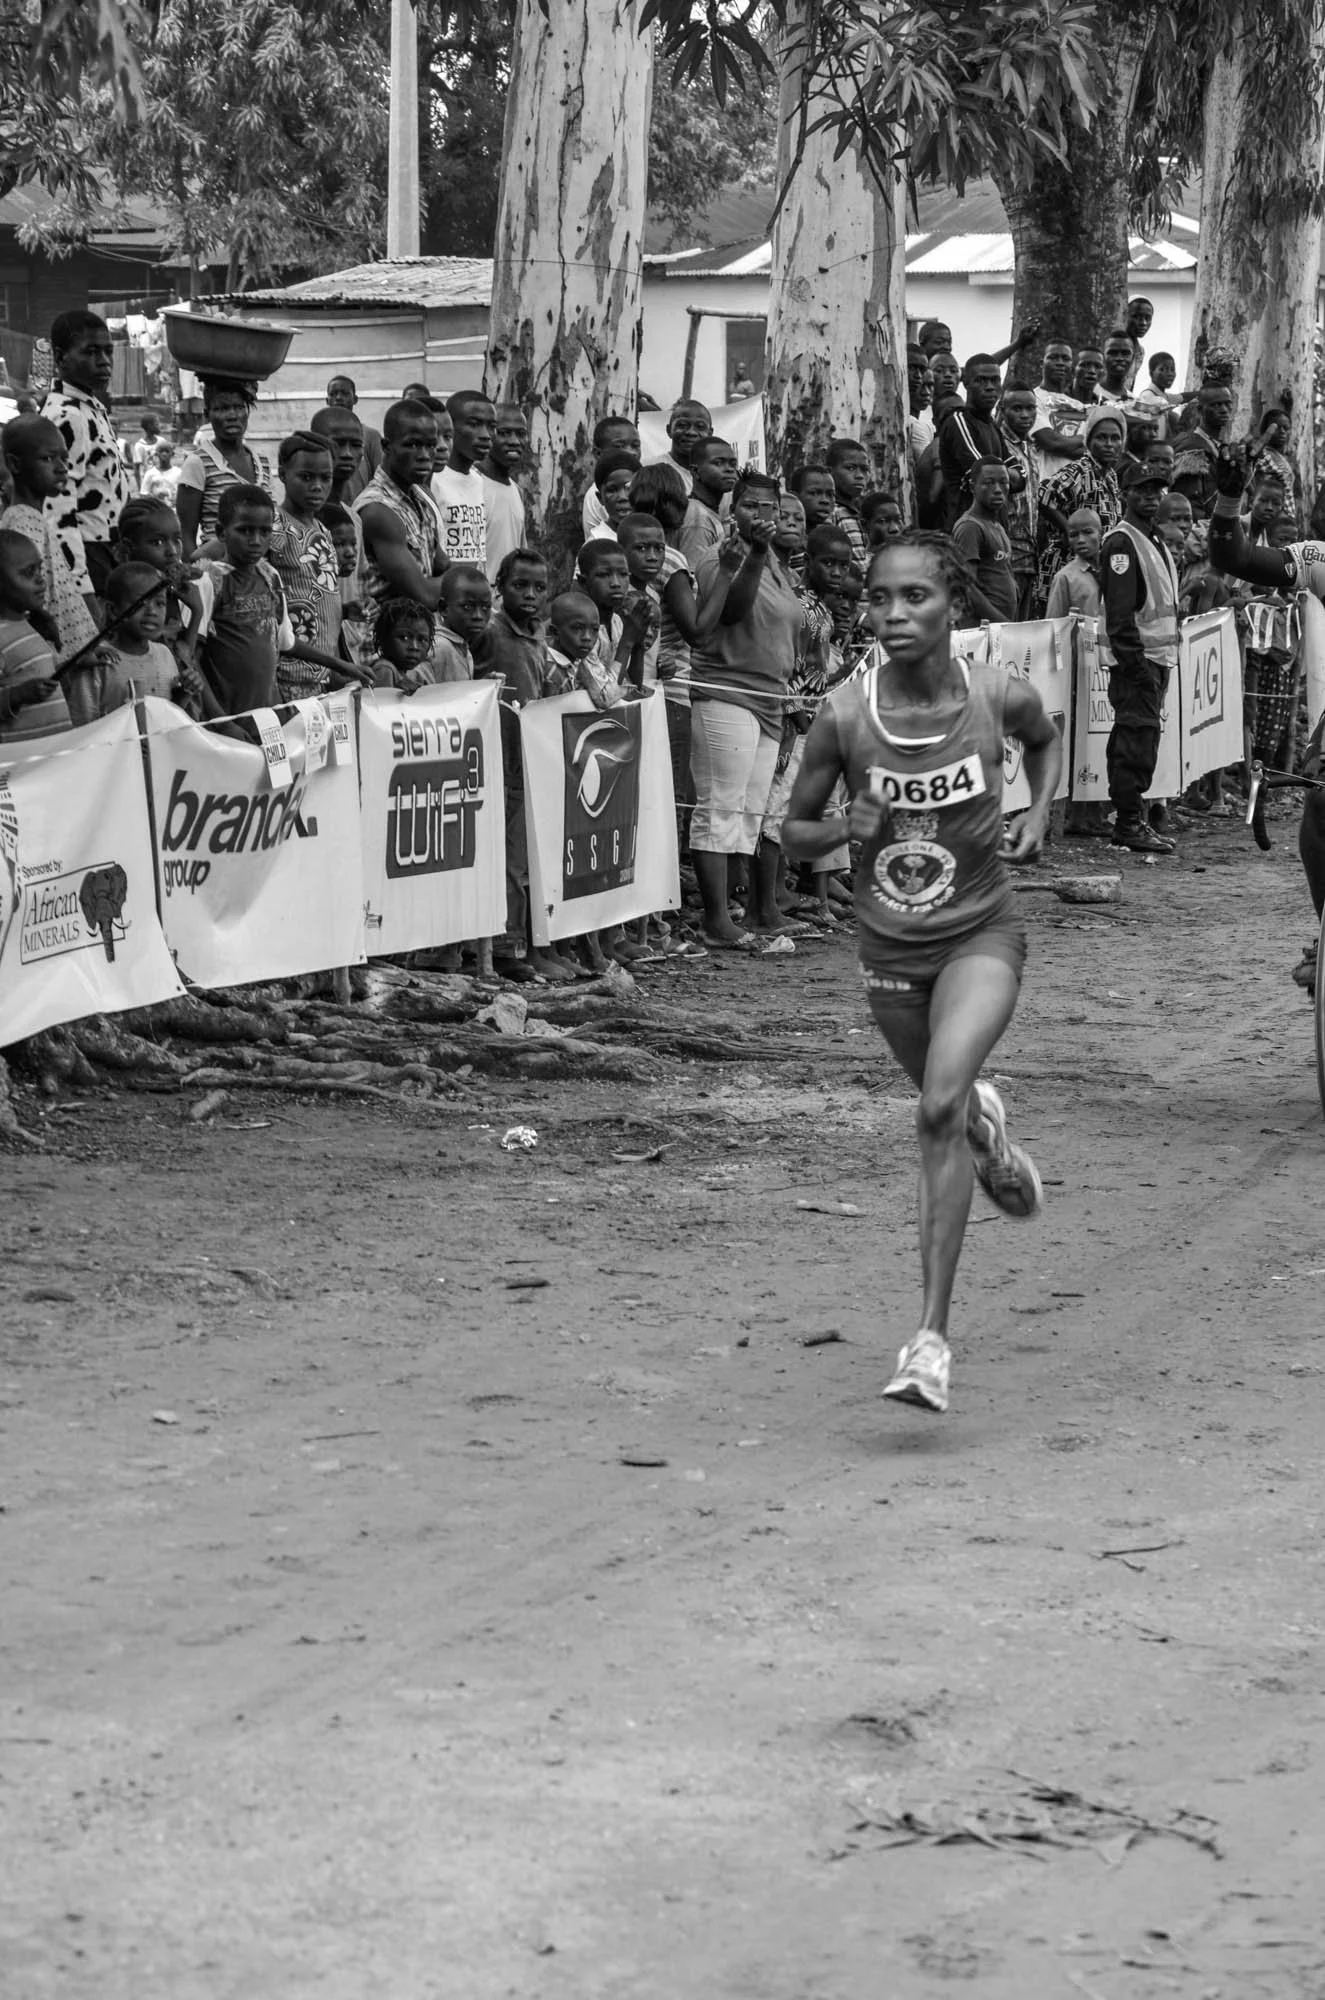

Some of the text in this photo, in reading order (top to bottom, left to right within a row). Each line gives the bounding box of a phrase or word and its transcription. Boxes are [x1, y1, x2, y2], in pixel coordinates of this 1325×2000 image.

[1192, 646, 1218, 716] AIG
[266, 743, 286, 764] CHILD
[392, 713, 462, 758] sierra
[882, 764, 974, 803] 0684
[163, 859, 211, 897] group
[23, 885, 79, 927] African
[23, 920, 80, 954] MINERALS
